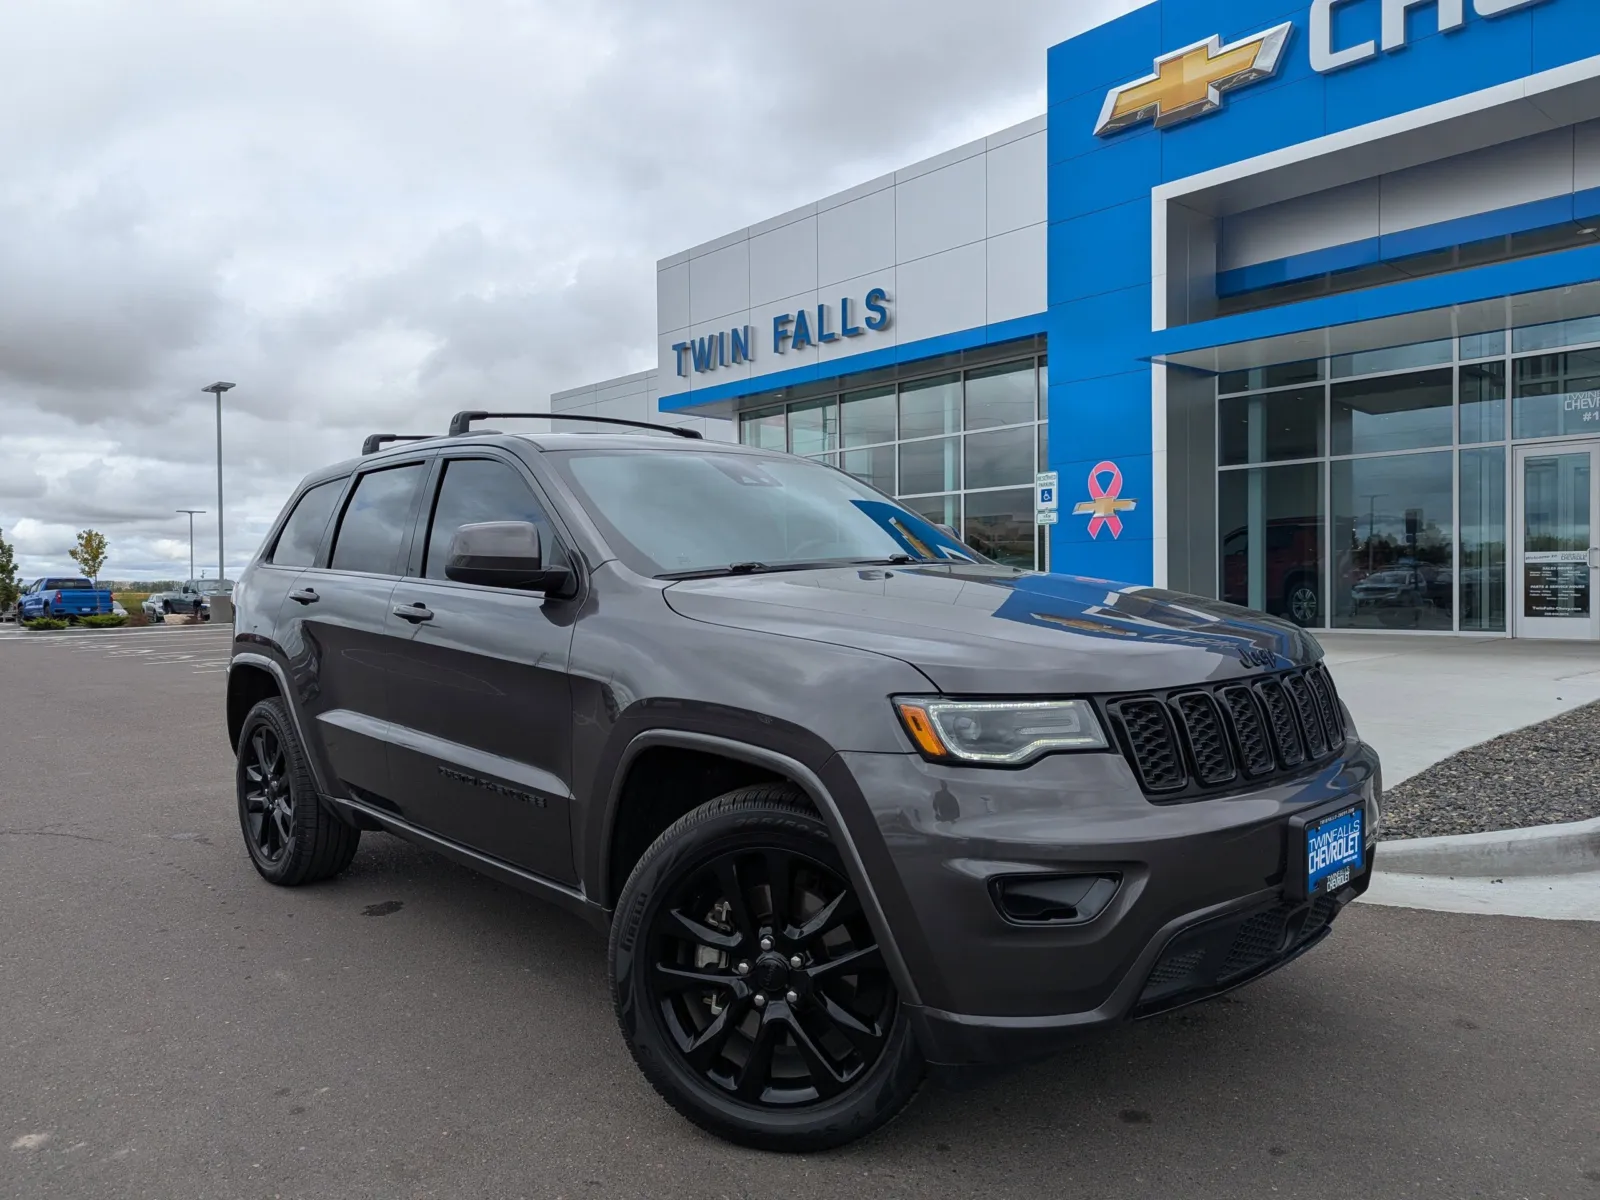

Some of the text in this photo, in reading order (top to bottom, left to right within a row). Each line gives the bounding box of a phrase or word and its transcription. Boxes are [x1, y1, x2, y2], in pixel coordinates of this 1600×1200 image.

[1309, 0, 1548, 74] CH
[672, 288, 891, 377] TWIN FALLS
[1308, 819, 1360, 852] TWINFALLS
[1308, 832, 1360, 874] CHEVROLET
[1326, 871, 1350, 892] CHEVROLET
